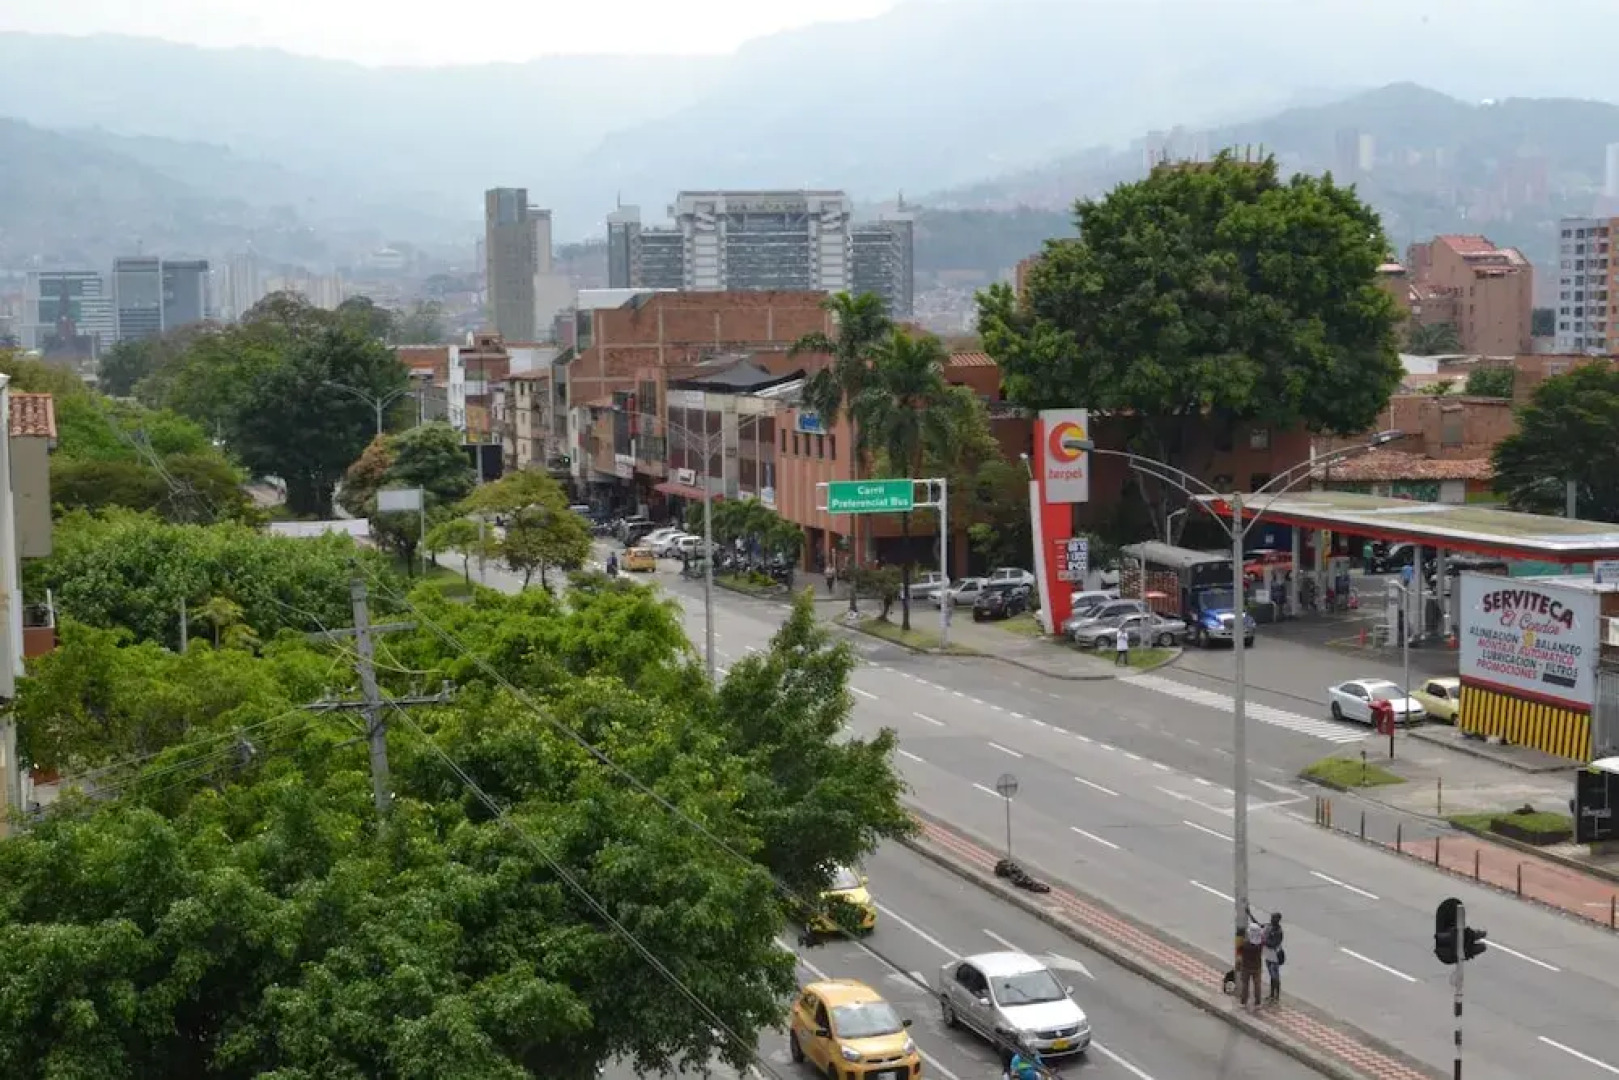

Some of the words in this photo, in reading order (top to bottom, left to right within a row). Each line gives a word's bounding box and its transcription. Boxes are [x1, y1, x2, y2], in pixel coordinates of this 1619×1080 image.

[1049, 468, 1083, 481] terpel
[831, 498, 888, 509] Preferencial
[890, 496, 909, 506] Bus
[857, 485, 885, 495] Carril
[1482, 590, 1574, 629] SERVITECA
[1469, 627, 1520, 643] ALINEACION
[1535, 638, 1582, 657] BALANCEO
[1477, 638, 1516, 654] MONTAJE
[1517, 646, 1575, 667] AUTOMATICO
[1476, 658, 1538, 680] PROMOCIONES
[1482, 649, 1537, 669] LUBRICACION
[1545, 662, 1579, 678] FILTROS
